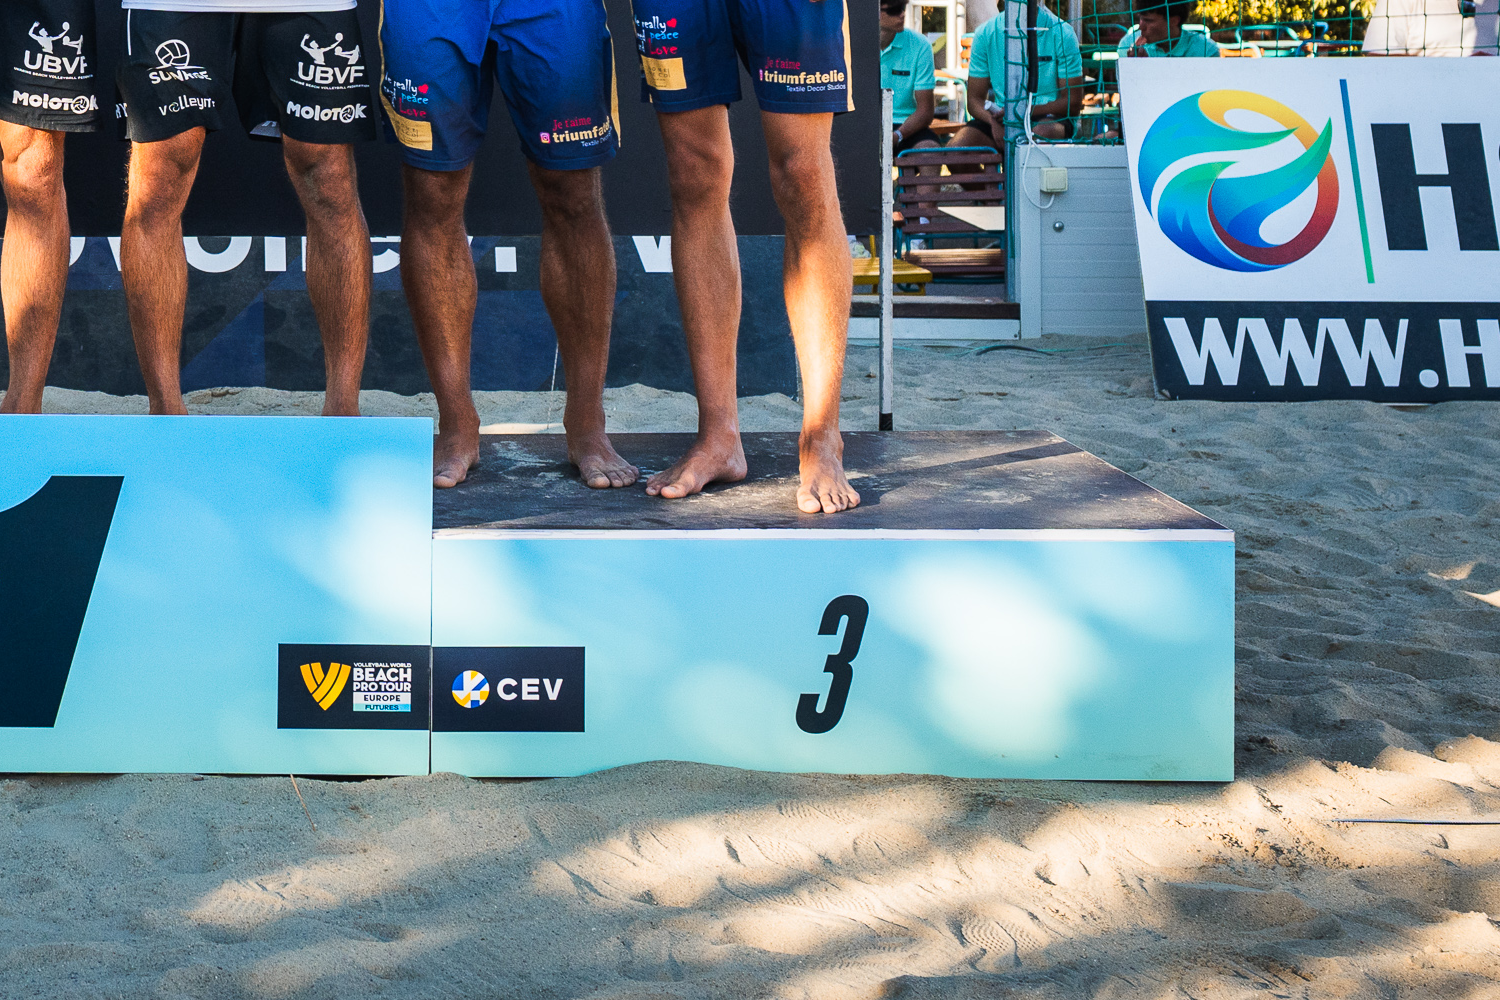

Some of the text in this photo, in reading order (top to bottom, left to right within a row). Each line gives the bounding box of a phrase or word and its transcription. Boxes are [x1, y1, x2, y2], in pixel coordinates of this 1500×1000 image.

[641, 15, 667, 33] really
[648, 37, 678, 55] Love
[649, 31, 679, 43] peace
[24, 49, 88, 74] UBVF
[298, 61, 365, 84] UBVF
[764, 69, 845, 85] triumfatelie
[393, 78, 417, 97] really
[401, 92, 429, 104] peace
[399, 97, 427, 118] Love
[553, 116, 592, 132] Je t'aime
[1163, 317, 1500, 388] WWW.H
[795, 594, 869, 734] 3
[353, 668, 412, 682] BEACH
[353, 682, 412, 692] PRO TOUR
[496, 677, 564, 701] CEV
[363, 694, 401, 702] EUROPE
